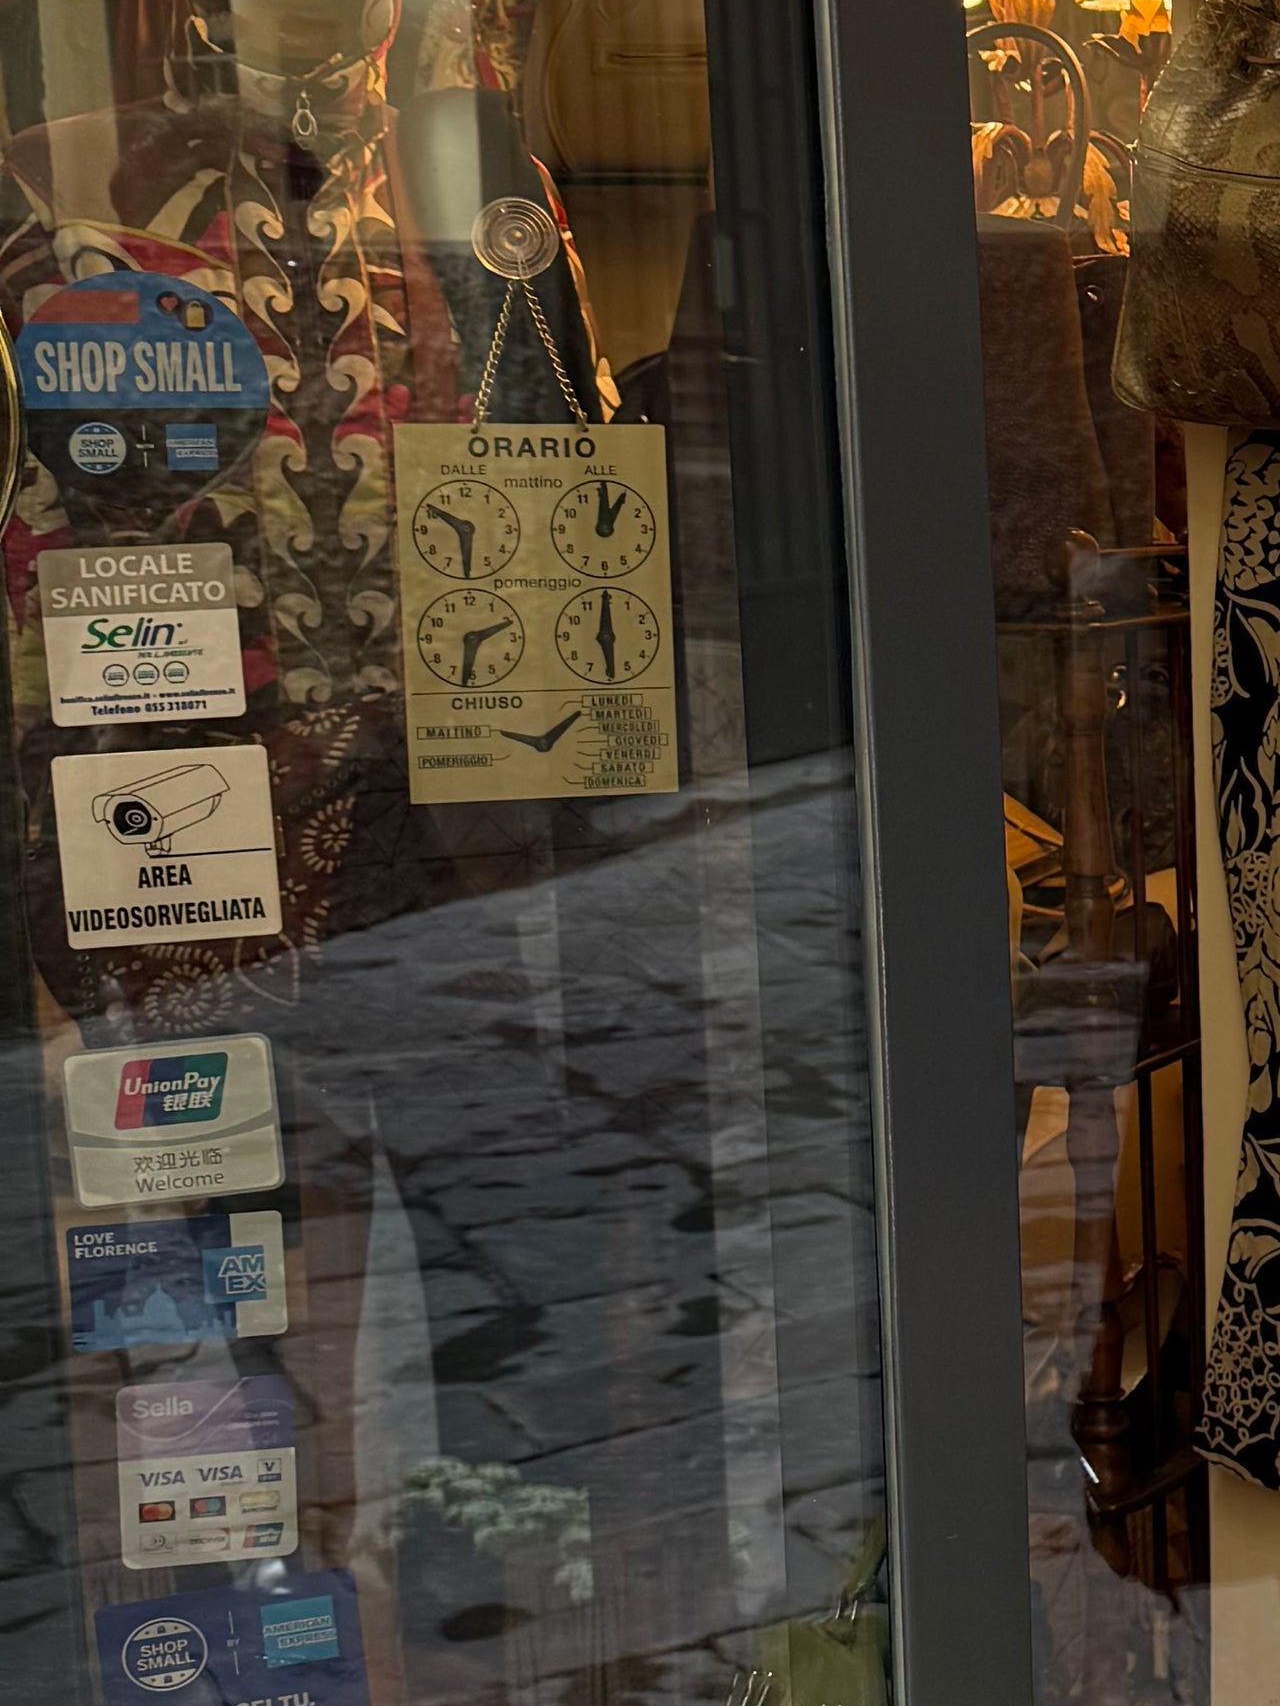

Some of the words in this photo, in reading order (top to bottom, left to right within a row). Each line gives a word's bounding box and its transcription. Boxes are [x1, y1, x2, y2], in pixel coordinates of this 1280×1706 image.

[34, 342, 126, 392] SHOP
[134, 342, 242, 392] SMALL
[81, 438, 114, 448] SHOP
[468, 436, 596, 458] ORARIO
[78, 448, 118, 458] SMALL
[441, 464, 487, 476] DALLE
[585, 464, 617, 476] ALLE
[504, 477, 563, 489] mattino
[459, 487, 472, 498] 12
[440, 494, 451, 505] 11
[484, 494, 490, 504] 1
[577, 494, 588, 504] 11
[498, 508, 505, 519] 2
[564, 508, 577, 519] 10
[634, 508, 641, 518] 2
[420, 525, 428, 535] 9
[505, 524, 513, 535] 3
[558, 524, 566, 534] 9
[641, 524, 648, 534] 3
[428, 544, 437, 555] 8
[498, 544, 506, 554] 4
[567, 544, 574, 554] 8
[635, 544, 641, 553] 4
[80, 553, 194, 578] LOCALE
[444, 557, 453, 568] 7
[484, 556, 491, 566] 5
[582, 556, 590, 566] 7
[601, 560, 609, 571] 6
[620, 555, 627, 565] 5
[494, 577, 581, 591] pomeriggio
[51, 580, 226, 609] SANIFICATO
[463, 595, 476, 606] 12
[581, 601, 592, 611] 11
[624, 601, 630, 611] 1
[445, 603, 455, 613] 11
[489, 602, 494, 612] 1
[431, 617, 443, 628] 10
[568, 615, 580, 626] 10
[638, 614, 645, 625] 2
[81, 617, 176, 650] Selin
[425, 634, 432, 644] 9
[509, 632, 517, 643] 3
[563, 631, 570, 642] 9
[645, 630, 652, 640] 3
[434, 653, 441, 664] 8
[503, 652, 511, 662] 4
[571, 651, 578, 661] 8
[638, 649, 645, 659] 4
[449, 665, 457, 675] 7
[488, 664, 495, 674] 5
[587, 662, 594, 672] 7
[624, 661, 631, 671] 5
[452, 696, 523, 710] CHIUSO
[91, 704, 141, 716] Telefono
[426, 727, 482, 739] MATTINO
[421, 757, 488, 767] POMERIGGIO
[601, 763, 645, 773] SABATO
[587, 777, 641, 787] DOMENICA
[138, 863, 192, 888] AREA
[68, 897, 266, 932] VIDEOSORVEGLIATA
[124, 1072, 220, 1095] UnionPay
[163, 1091, 213, 1111] 银联
[133, 1148, 223, 1173] 欢迎光临
[136, 1172, 224, 1193] Welcome
[74, 1232, 114, 1246] LOVE
[74, 1242, 158, 1259] FLORENCE
[218, 1254, 264, 1277] AM
[226, 1273, 266, 1294] EX
[132, 1396, 193, 1419] Sella
[138, 1470, 186, 1487] VISA
[198, 1465, 243, 1482] VISA
[140, 1639, 188, 1658] SHOP
[137, 1651, 196, 1672] SMALL
